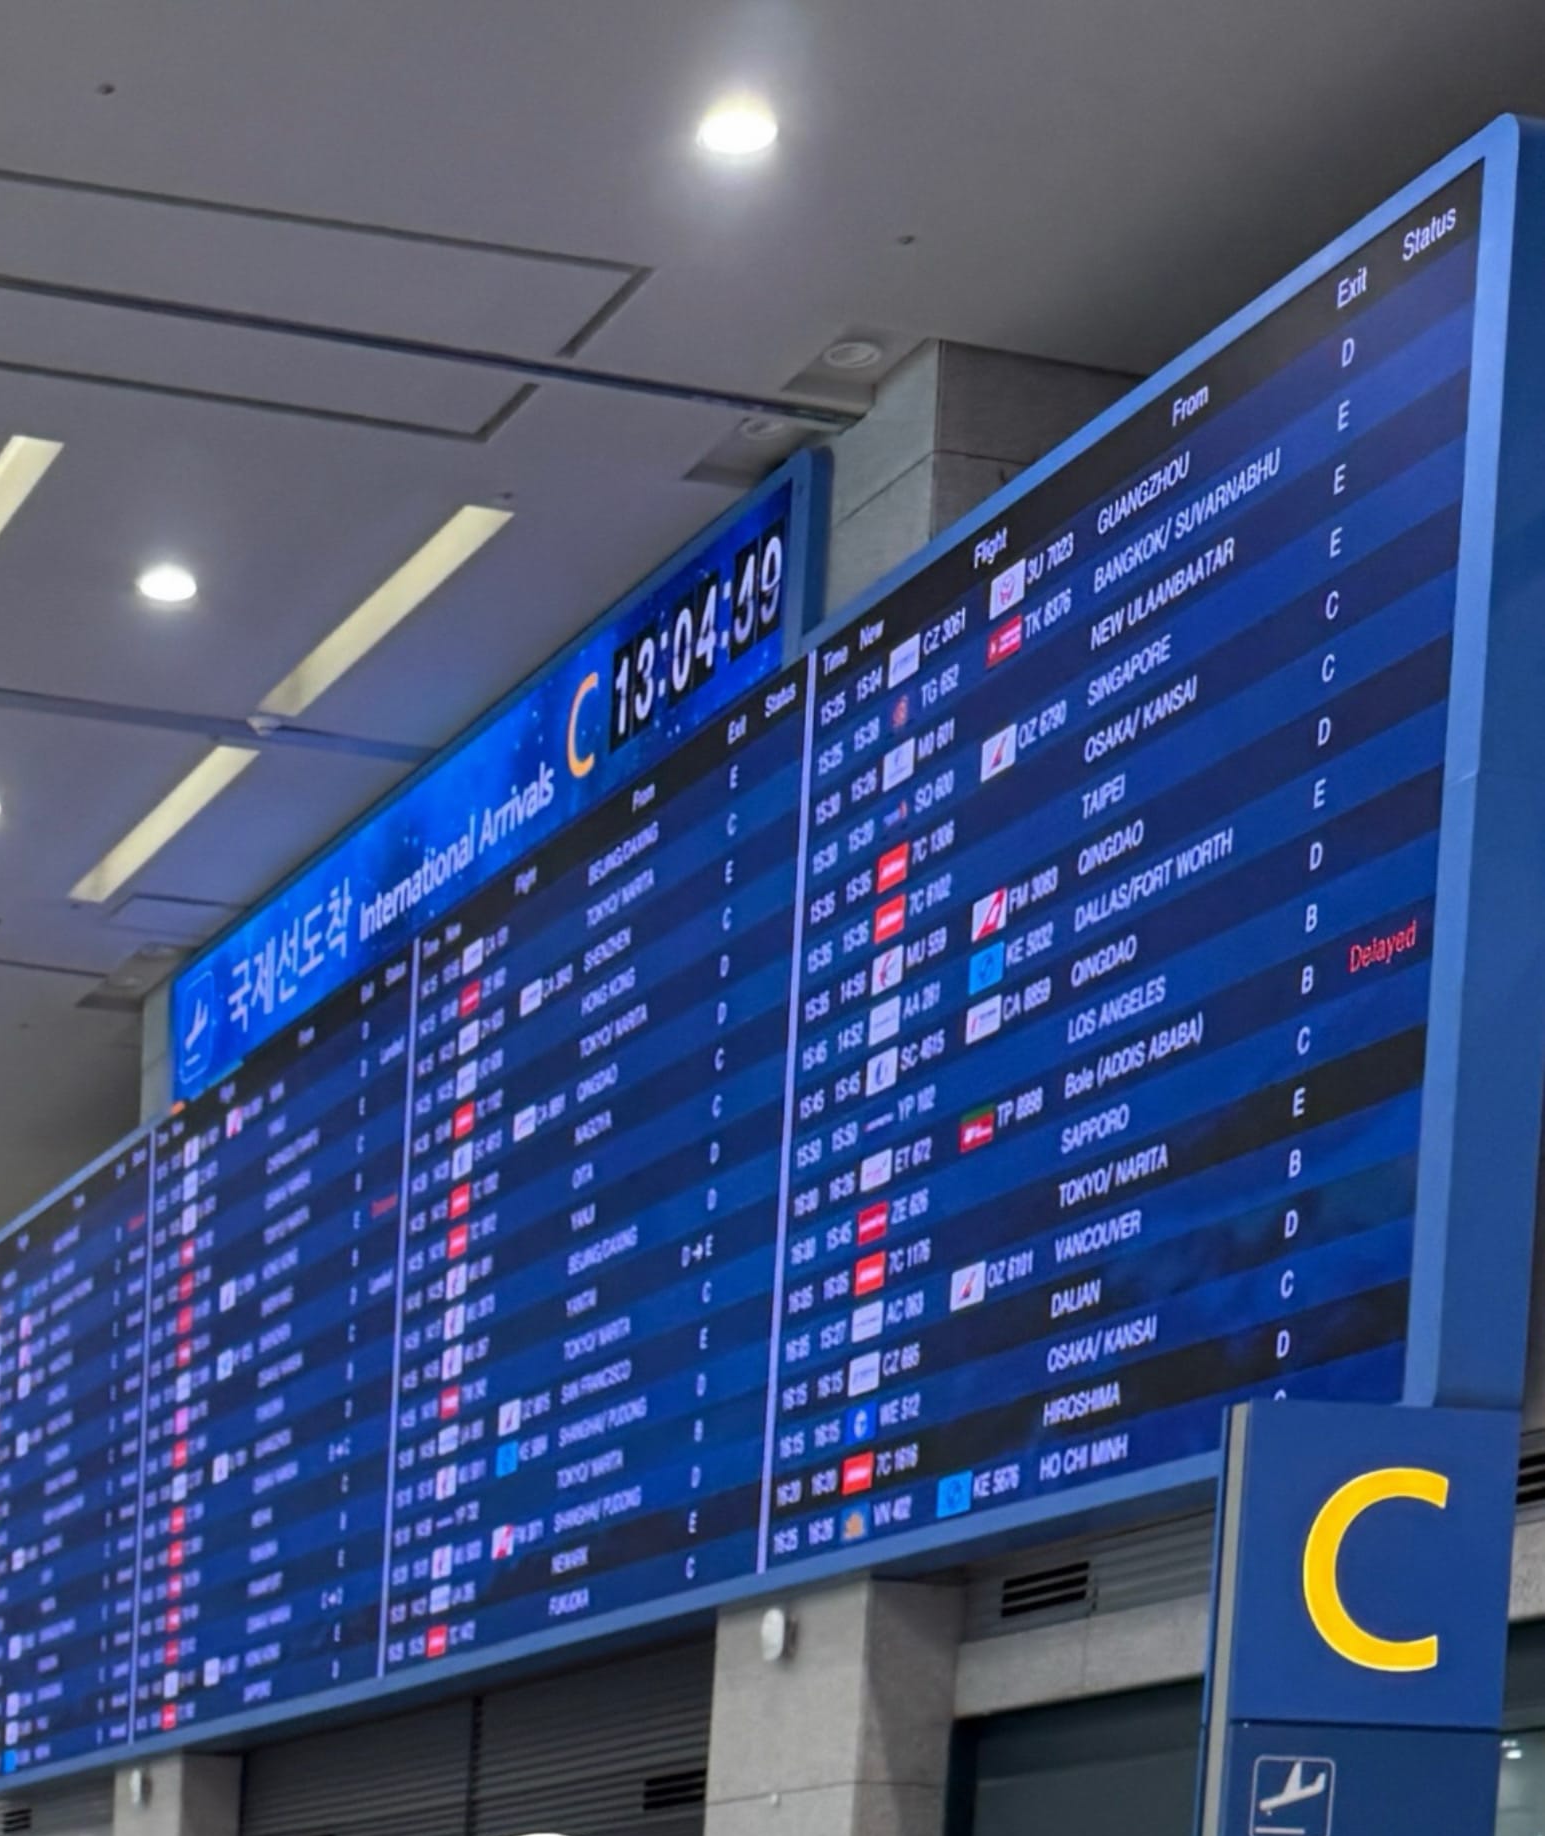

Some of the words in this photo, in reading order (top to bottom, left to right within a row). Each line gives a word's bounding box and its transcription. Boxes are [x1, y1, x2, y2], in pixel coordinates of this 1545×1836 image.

[1401, 207, 1456, 261] Status
[1336, 266, 1367, 308] Exit
[1171, 385, 1209, 426] From
[922, 624, 941, 655] CZ
[1097, 451, 1190, 534] GUANGZHOU
[1340, 336, 1355, 367] D
[973, 526, 1008, 568] Flight
[920, 677, 938, 707] TG
[1023, 606, 1042, 638] TK
[1093, 517, 1172, 592] BANGKOK/
[1174, 448, 1280, 538] SUVARNABHU
[1336, 399, 1350, 431] E
[1090, 607, 1125, 649] NEW
[1126, 537, 1234, 625] ULAANBAATAR
[1332, 463, 1346, 495] E
[822, 645, 849, 675] Time
[858, 619, 884, 650] New
[1017, 716, 1038, 749] OZ
[1087, 634, 1170, 705] SINGAPORE
[1328, 526, 1342, 558] E
[1083, 707, 1139, 762] OSAKA/
[1142, 675, 1197, 728] KANSAI
[1324, 589, 1339, 620] C
[567, 672, 598, 778] C
[764, 682, 796, 718] Status
[1082, 774, 1125, 818] TAIPEI
[1320, 652, 1335, 683] C
[725, 812, 737, 836] C
[729, 764, 738, 788] E
[1008, 882, 1029, 912] FM
[1077, 819, 1144, 875] QINGDAO
[1316, 716, 1331, 746] D
[359, 814, 476, 938] International
[478, 763, 554, 852] Arrivals
[724, 859, 733, 883] E
[1073, 858, 1172, 931] DALLAS/FORT
[1175, 828, 1233, 877] WORTH
[1312, 777, 1326, 809] E
[227, 878, 353, 1032] 국제선도착
[581, 983, 608, 1013] HONG
[608, 966, 635, 996] KONG
[721, 906, 732, 931] C
[1070, 934, 1137, 986] QINGDAO
[1308, 841, 1323, 871] D
[996, 1099, 1014, 1127] TP
[1063, 1067, 1094, 1099] Bole
[1096, 1040, 1145, 1085] (ADDIS
[1147, 1012, 1203, 1061] ABABA)
[1300, 965, 1313, 994] B
[1348, 920, 1417, 972] Delayed
[1067, 1008, 1096, 1043] LOS
[1098, 975, 1165, 1026] ANGELES
[1304, 903, 1317, 932] B
[711, 1094, 722, 1118] C
[713, 1047, 724, 1071] C
[1061, 1103, 1129, 1153] SAPPORO
[1295, 1025, 1311, 1055] C
[1058, 1163, 1113, 1207] TOKYO/
[1114, 1144, 1168, 1185] NARITA
[1292, 1086, 1305, 1117] E
[704, 1234, 713, 1256] E
[1054, 1209, 1141, 1261] VANCOUVER
[1288, 1148, 1301, 1177] B
[701, 1280, 711, 1303] C
[1050, 1279, 1100, 1318] DALIAN
[1283, 1209, 1298, 1238] D
[698, 1326, 708, 1349] E
[1046, 1331, 1102, 1372] OSAKA/
[1103, 1316, 1156, 1352] KANSAI
[1279, 1269, 1294, 1299] C
[1042, 1382, 1120, 1424] HIROSHIMA
[1275, 1329, 1290, 1358] D
[1039, 1452, 1061, 1480] HO
[1062, 1444, 1088, 1474] CHI
[1090, 1435, 1127, 1465] MINH
[684, 1556, 695, 1579] C
[687, 1511, 697, 1534] E
[1302, 1466, 1449, 1672] C
